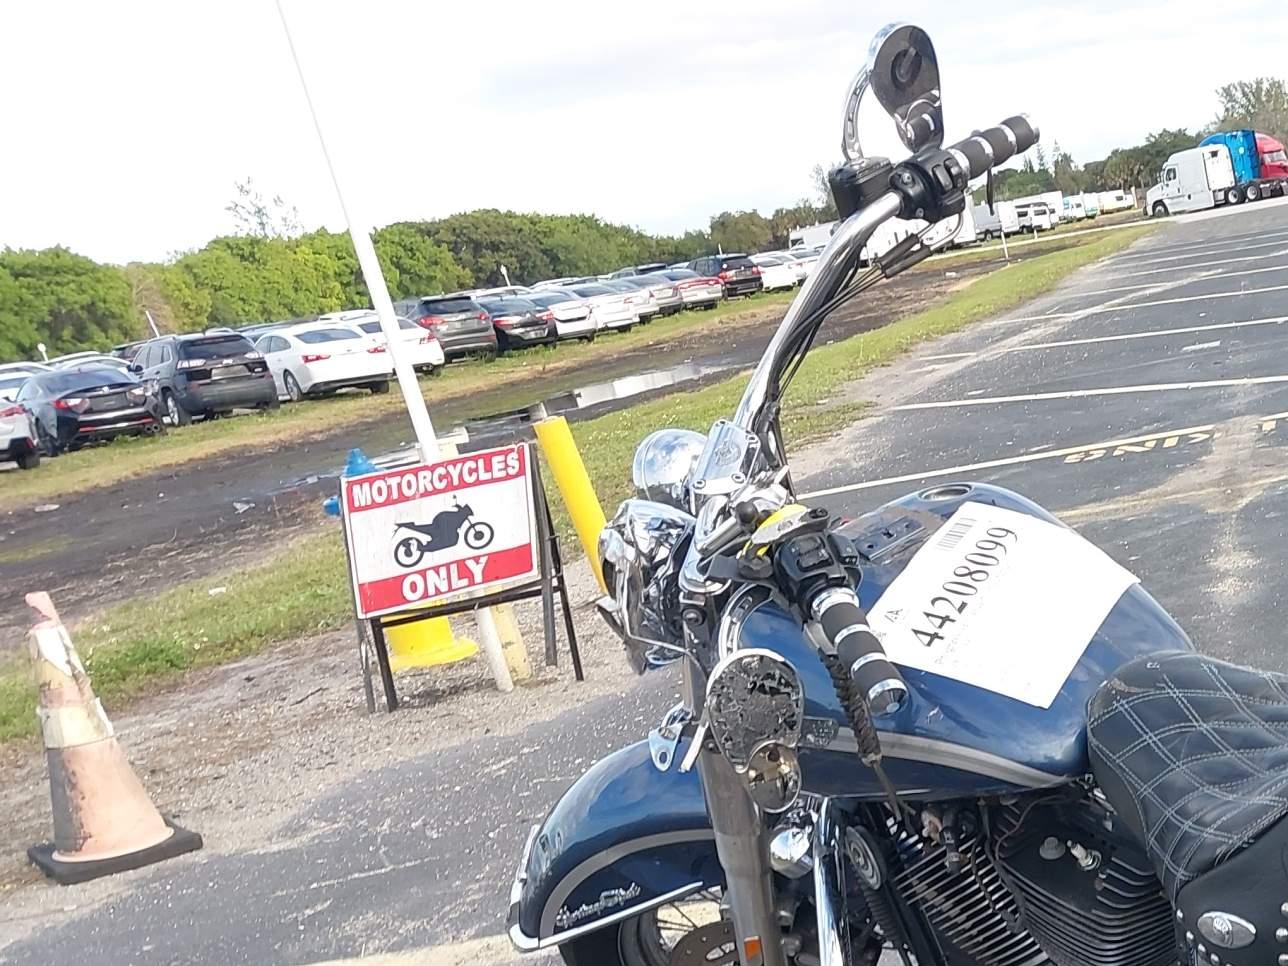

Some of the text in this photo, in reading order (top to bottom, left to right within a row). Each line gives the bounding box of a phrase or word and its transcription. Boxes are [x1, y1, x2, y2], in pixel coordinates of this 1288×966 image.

[352, 452, 520, 508] MOTORCYCLES
[402, 556, 489, 601] ONLY
[911, 526, 1018, 647] 44208099
